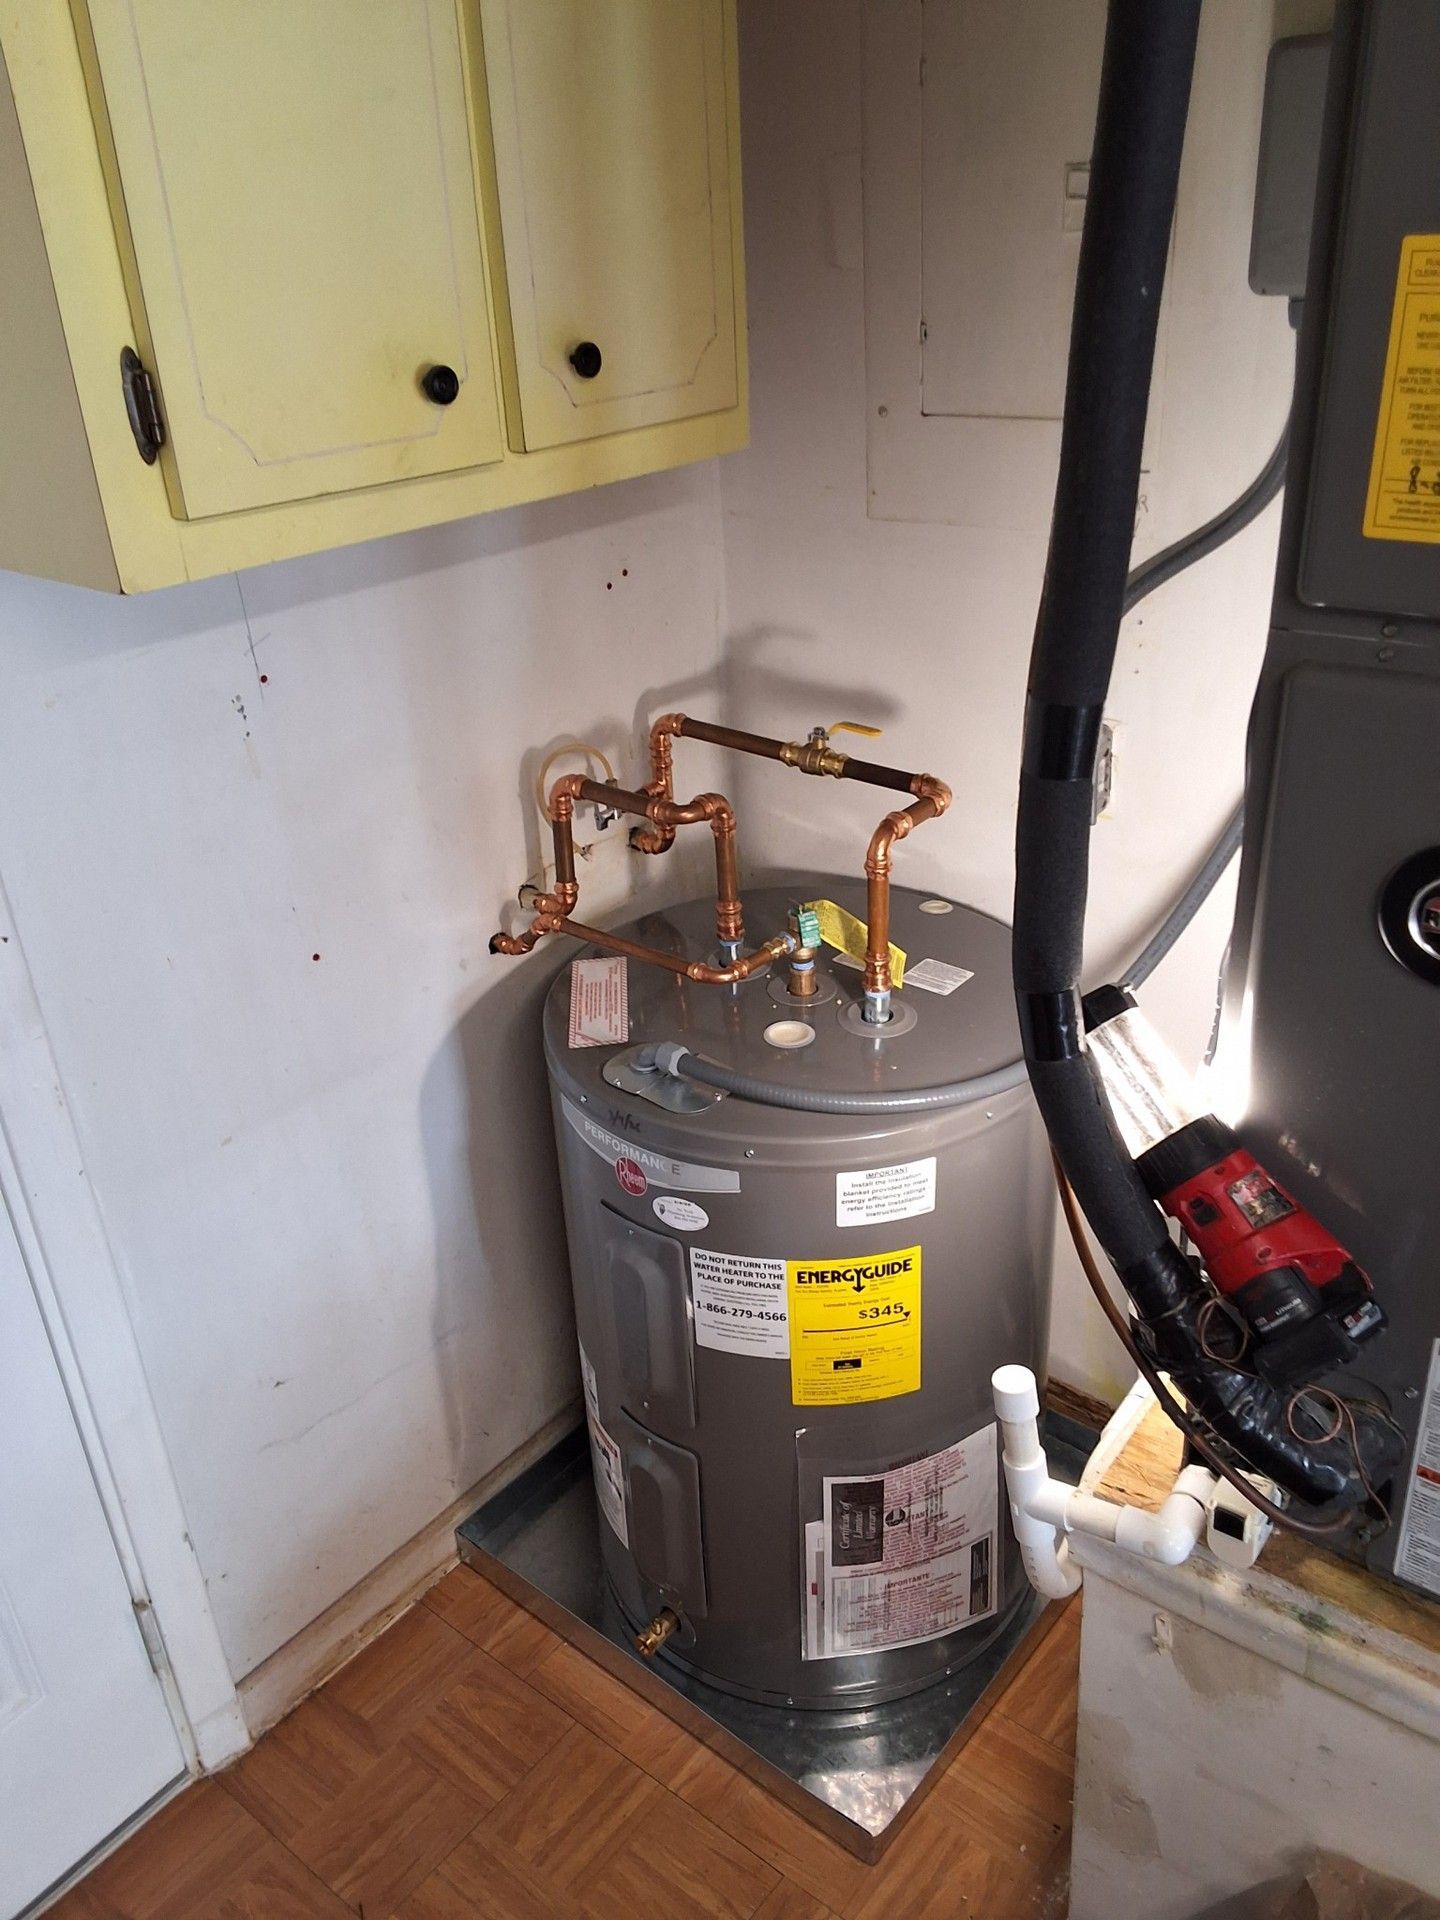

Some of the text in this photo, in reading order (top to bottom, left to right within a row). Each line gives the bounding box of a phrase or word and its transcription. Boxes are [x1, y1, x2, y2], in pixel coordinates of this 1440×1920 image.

[619, 1157, 645, 1188] Rheem
[866, 1167, 908, 1179] IMPORTANT
[841, 1197, 866, 1205] energy
[867, 1193, 902, 1202] efficiency
[843, 1189, 870, 1197] blanket
[871, 1184, 903, 1195] provided
[693, 1261, 785, 1281] WATER HEATER TO THE
[694, 1252, 782, 1271] DO NOT RETURN THIS
[697, 1271, 722, 1284] PLACE
[724, 1276, 735, 1286] OF
[736, 1279, 782, 1291] PURCHASE
[796, 1258, 913, 1285] ENERGYGUIDE
[696, 1300, 788, 1322] 1-866-279-4566
[858, 1302, 905, 1320] $345
